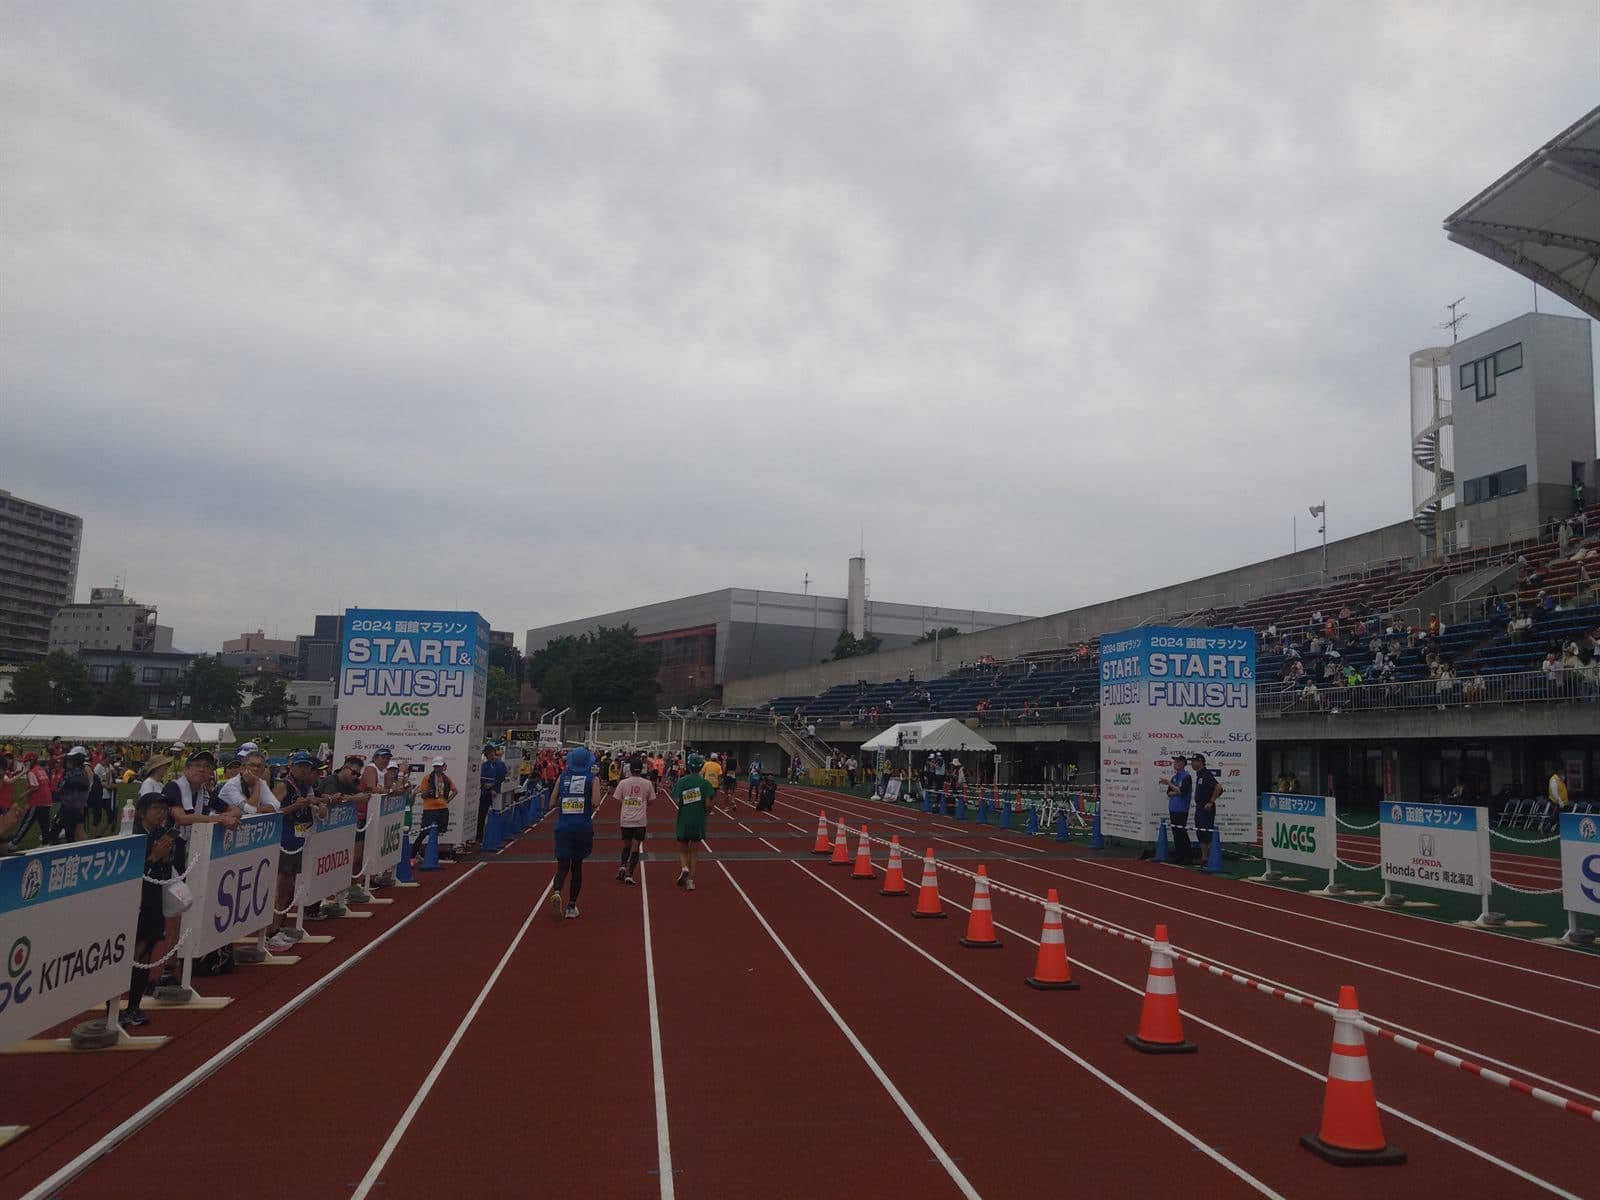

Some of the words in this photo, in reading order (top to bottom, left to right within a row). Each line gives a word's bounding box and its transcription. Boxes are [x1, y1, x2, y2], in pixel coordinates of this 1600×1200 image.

[352, 620, 392, 632] 2024
[395, 620, 468, 634] 函館マラソン
[1150, 637, 1184, 648] 2024
[1186, 637, 1248, 650] 函館マラソン
[344, 668, 464, 696] FINISH
[1103, 680, 1140, 706] FINISH
[1148, 681, 1249, 708] FINISH
[379, 702, 430, 717] JACCS
[1179, 712, 1221, 726] JACCS
[340, 724, 384, 732] HONDA
[437, 724, 465, 735] SEC
[1228, 733, 1253, 742] SEC
[1405, 806, 1463, 826] 函館マラソン
[1271, 822, 1316, 854] JACCS
[47, 848, 131, 893] 函館マラソン
[317, 848, 349, 876] HONDA
[1385, 862, 1416, 878] Honda
[1418, 865, 1440, 882] Cars
[1412, 857, 1442, 868] HONDA
[214, 858, 271, 933] SEC
[39, 932, 127, 994] KITAGAS
